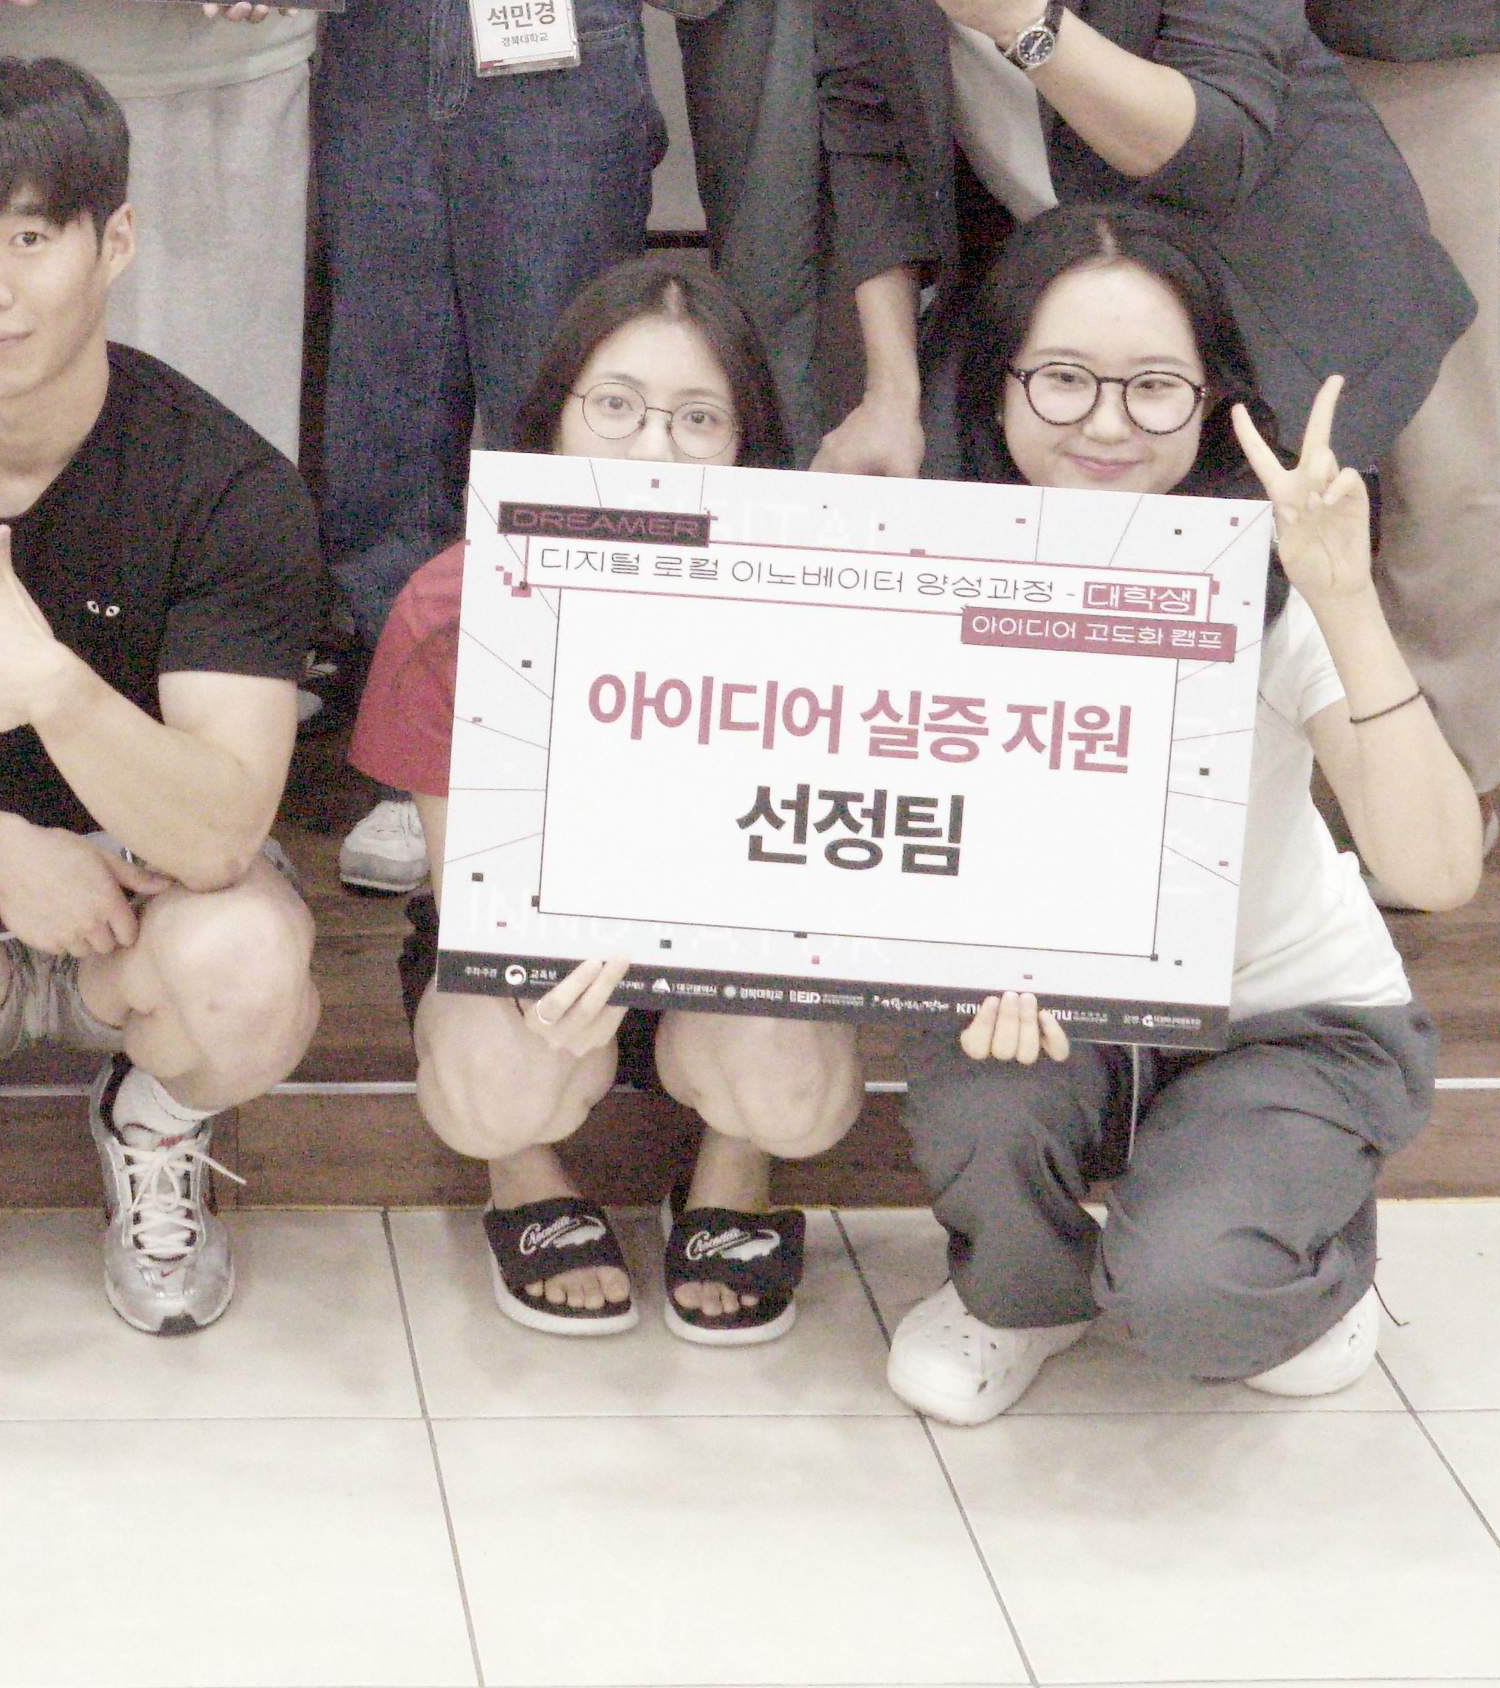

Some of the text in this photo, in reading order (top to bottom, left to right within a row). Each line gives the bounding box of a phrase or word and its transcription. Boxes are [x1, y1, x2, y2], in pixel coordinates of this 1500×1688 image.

[487, 0, 556, 30] 석민경
[501, 32, 548, 47] 경북대학교
[540, 548, 1195, 614] 디지털 로컬 이노베이터 양성과정 대학생
[972, 614, 1223, 651] 아이디어 고도화 캠프
[588, 671, 1130, 774] 아이디어 실증 지원
[735, 784, 965, 878] 선정팀
